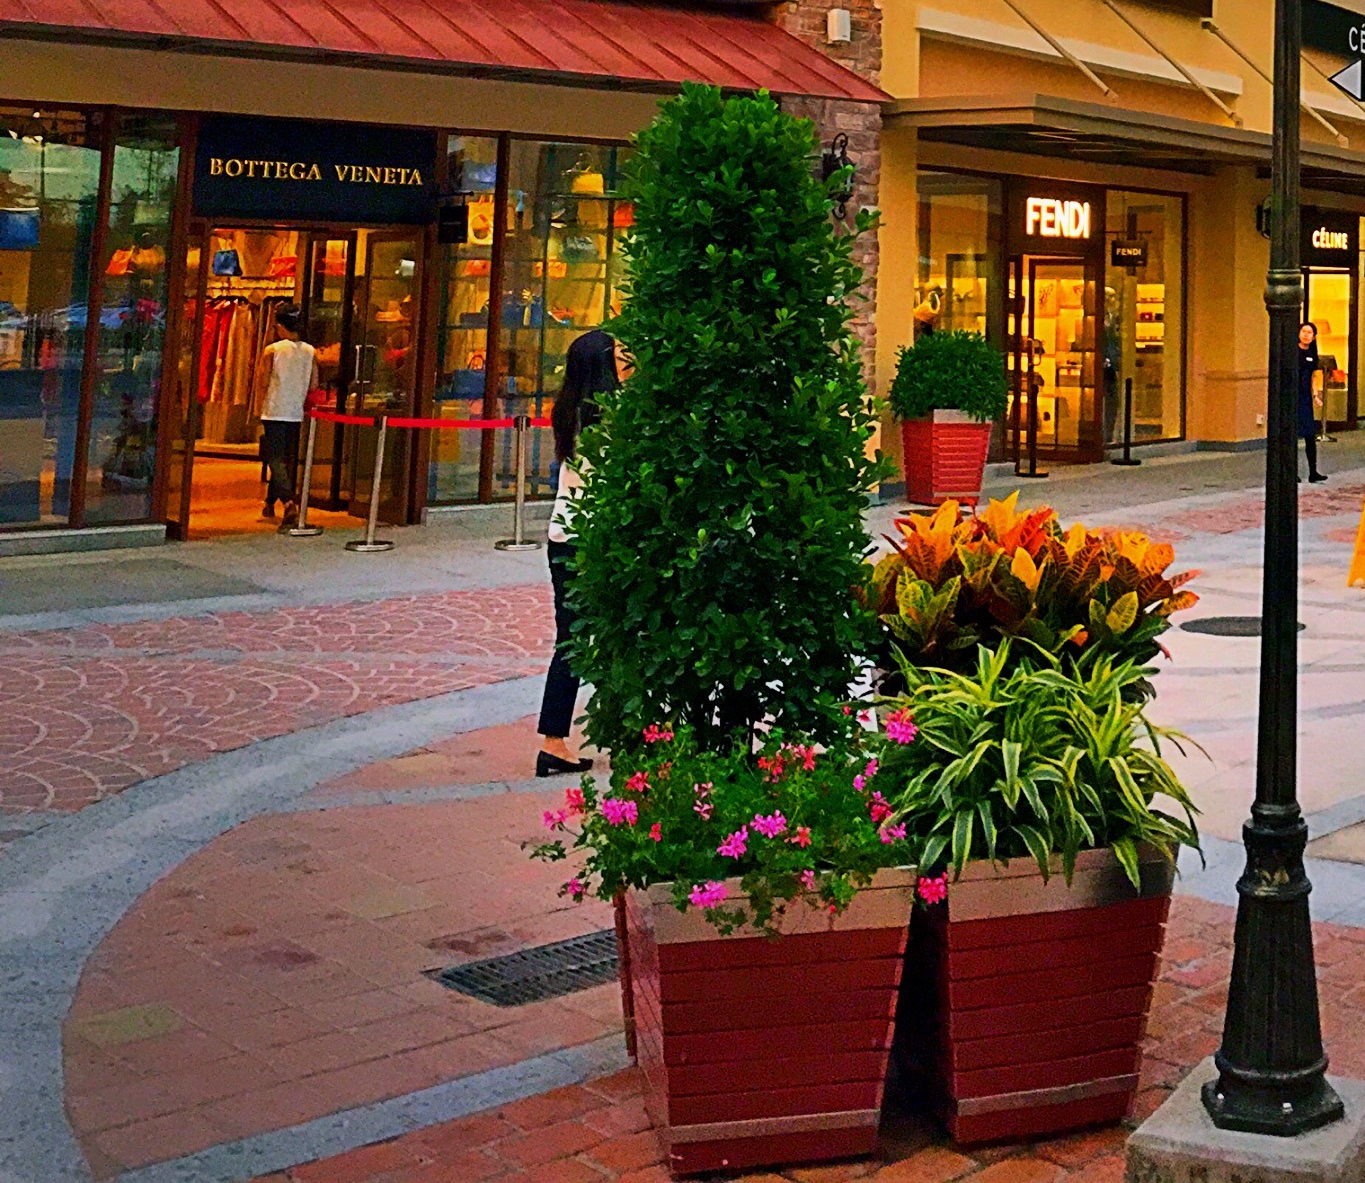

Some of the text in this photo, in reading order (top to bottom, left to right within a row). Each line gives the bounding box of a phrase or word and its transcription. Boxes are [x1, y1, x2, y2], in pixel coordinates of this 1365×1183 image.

[210, 157, 424, 186] BOTTEGA VENETA
[1026, 197, 1091, 239] FENDI
[1312, 226, 1349, 250] CÉLINE
[1116, 247, 1142, 256] FENDI
